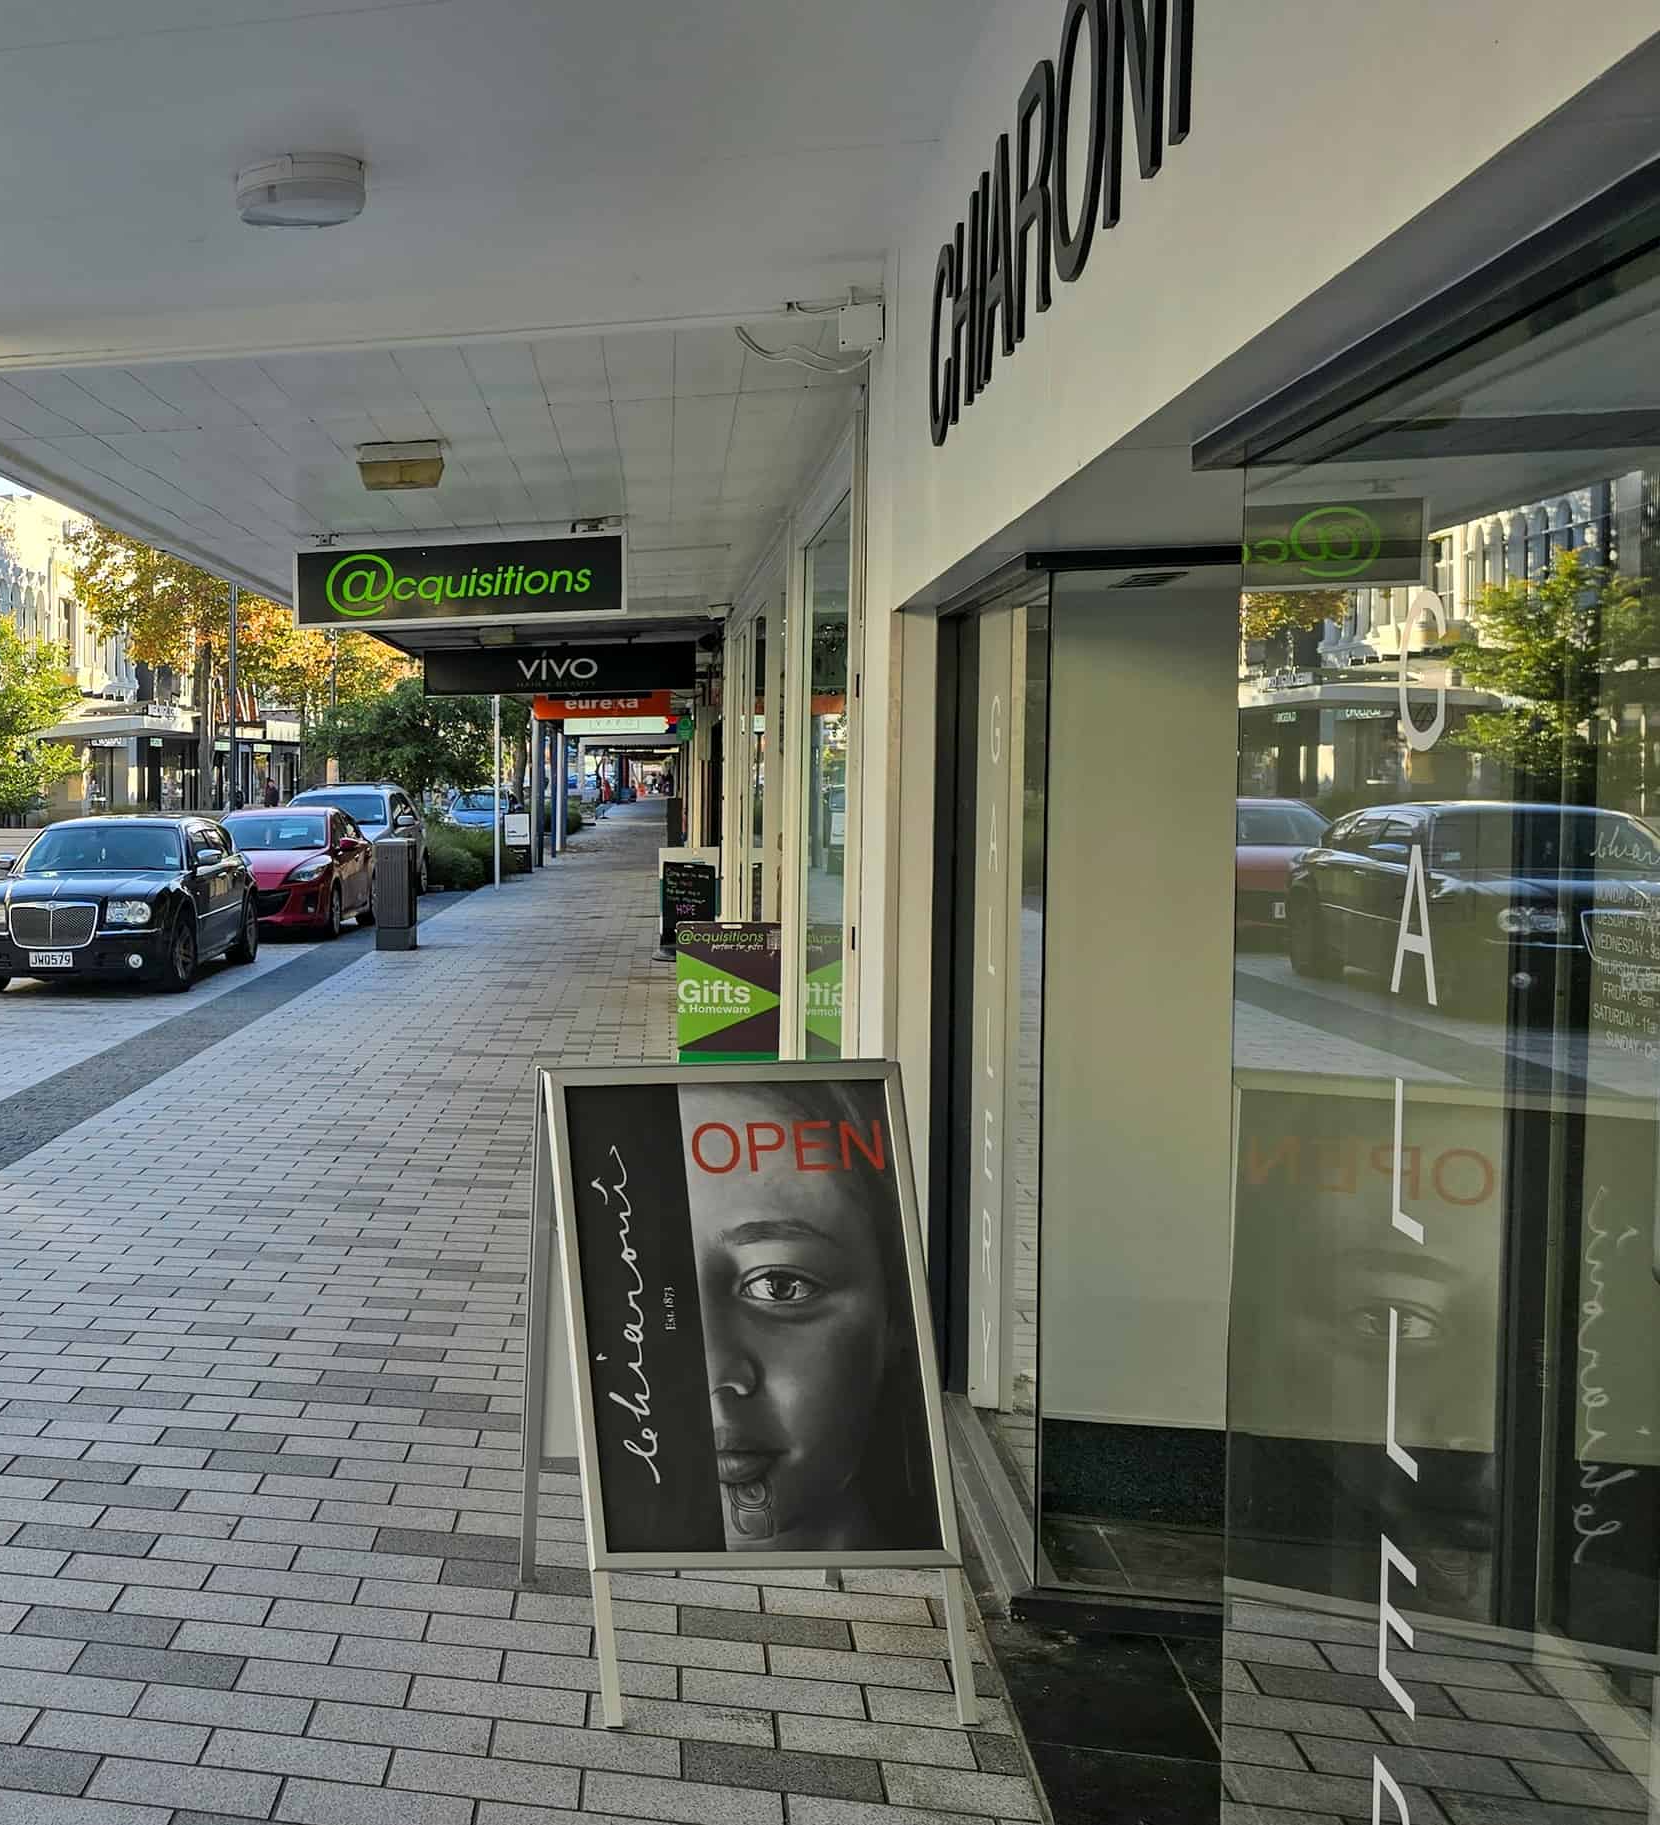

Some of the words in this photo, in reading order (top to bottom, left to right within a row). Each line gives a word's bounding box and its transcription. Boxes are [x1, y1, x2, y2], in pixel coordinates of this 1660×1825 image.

[325, 552, 592, 618] @cquisitions
[677, 929, 765, 945] @cquisitions
[677, 978, 751, 1004] Gifts
[1602, 981, 1632, 1002] FRIDAY
[677, 1005, 686, 1014] &
[689, 1004, 751, 1014] Homeware
[1592, 1001, 1637, 1026] SATURDAY
[690, 1118, 886, 1176] OPEN
[663, 1286, 676, 1308] 1873
